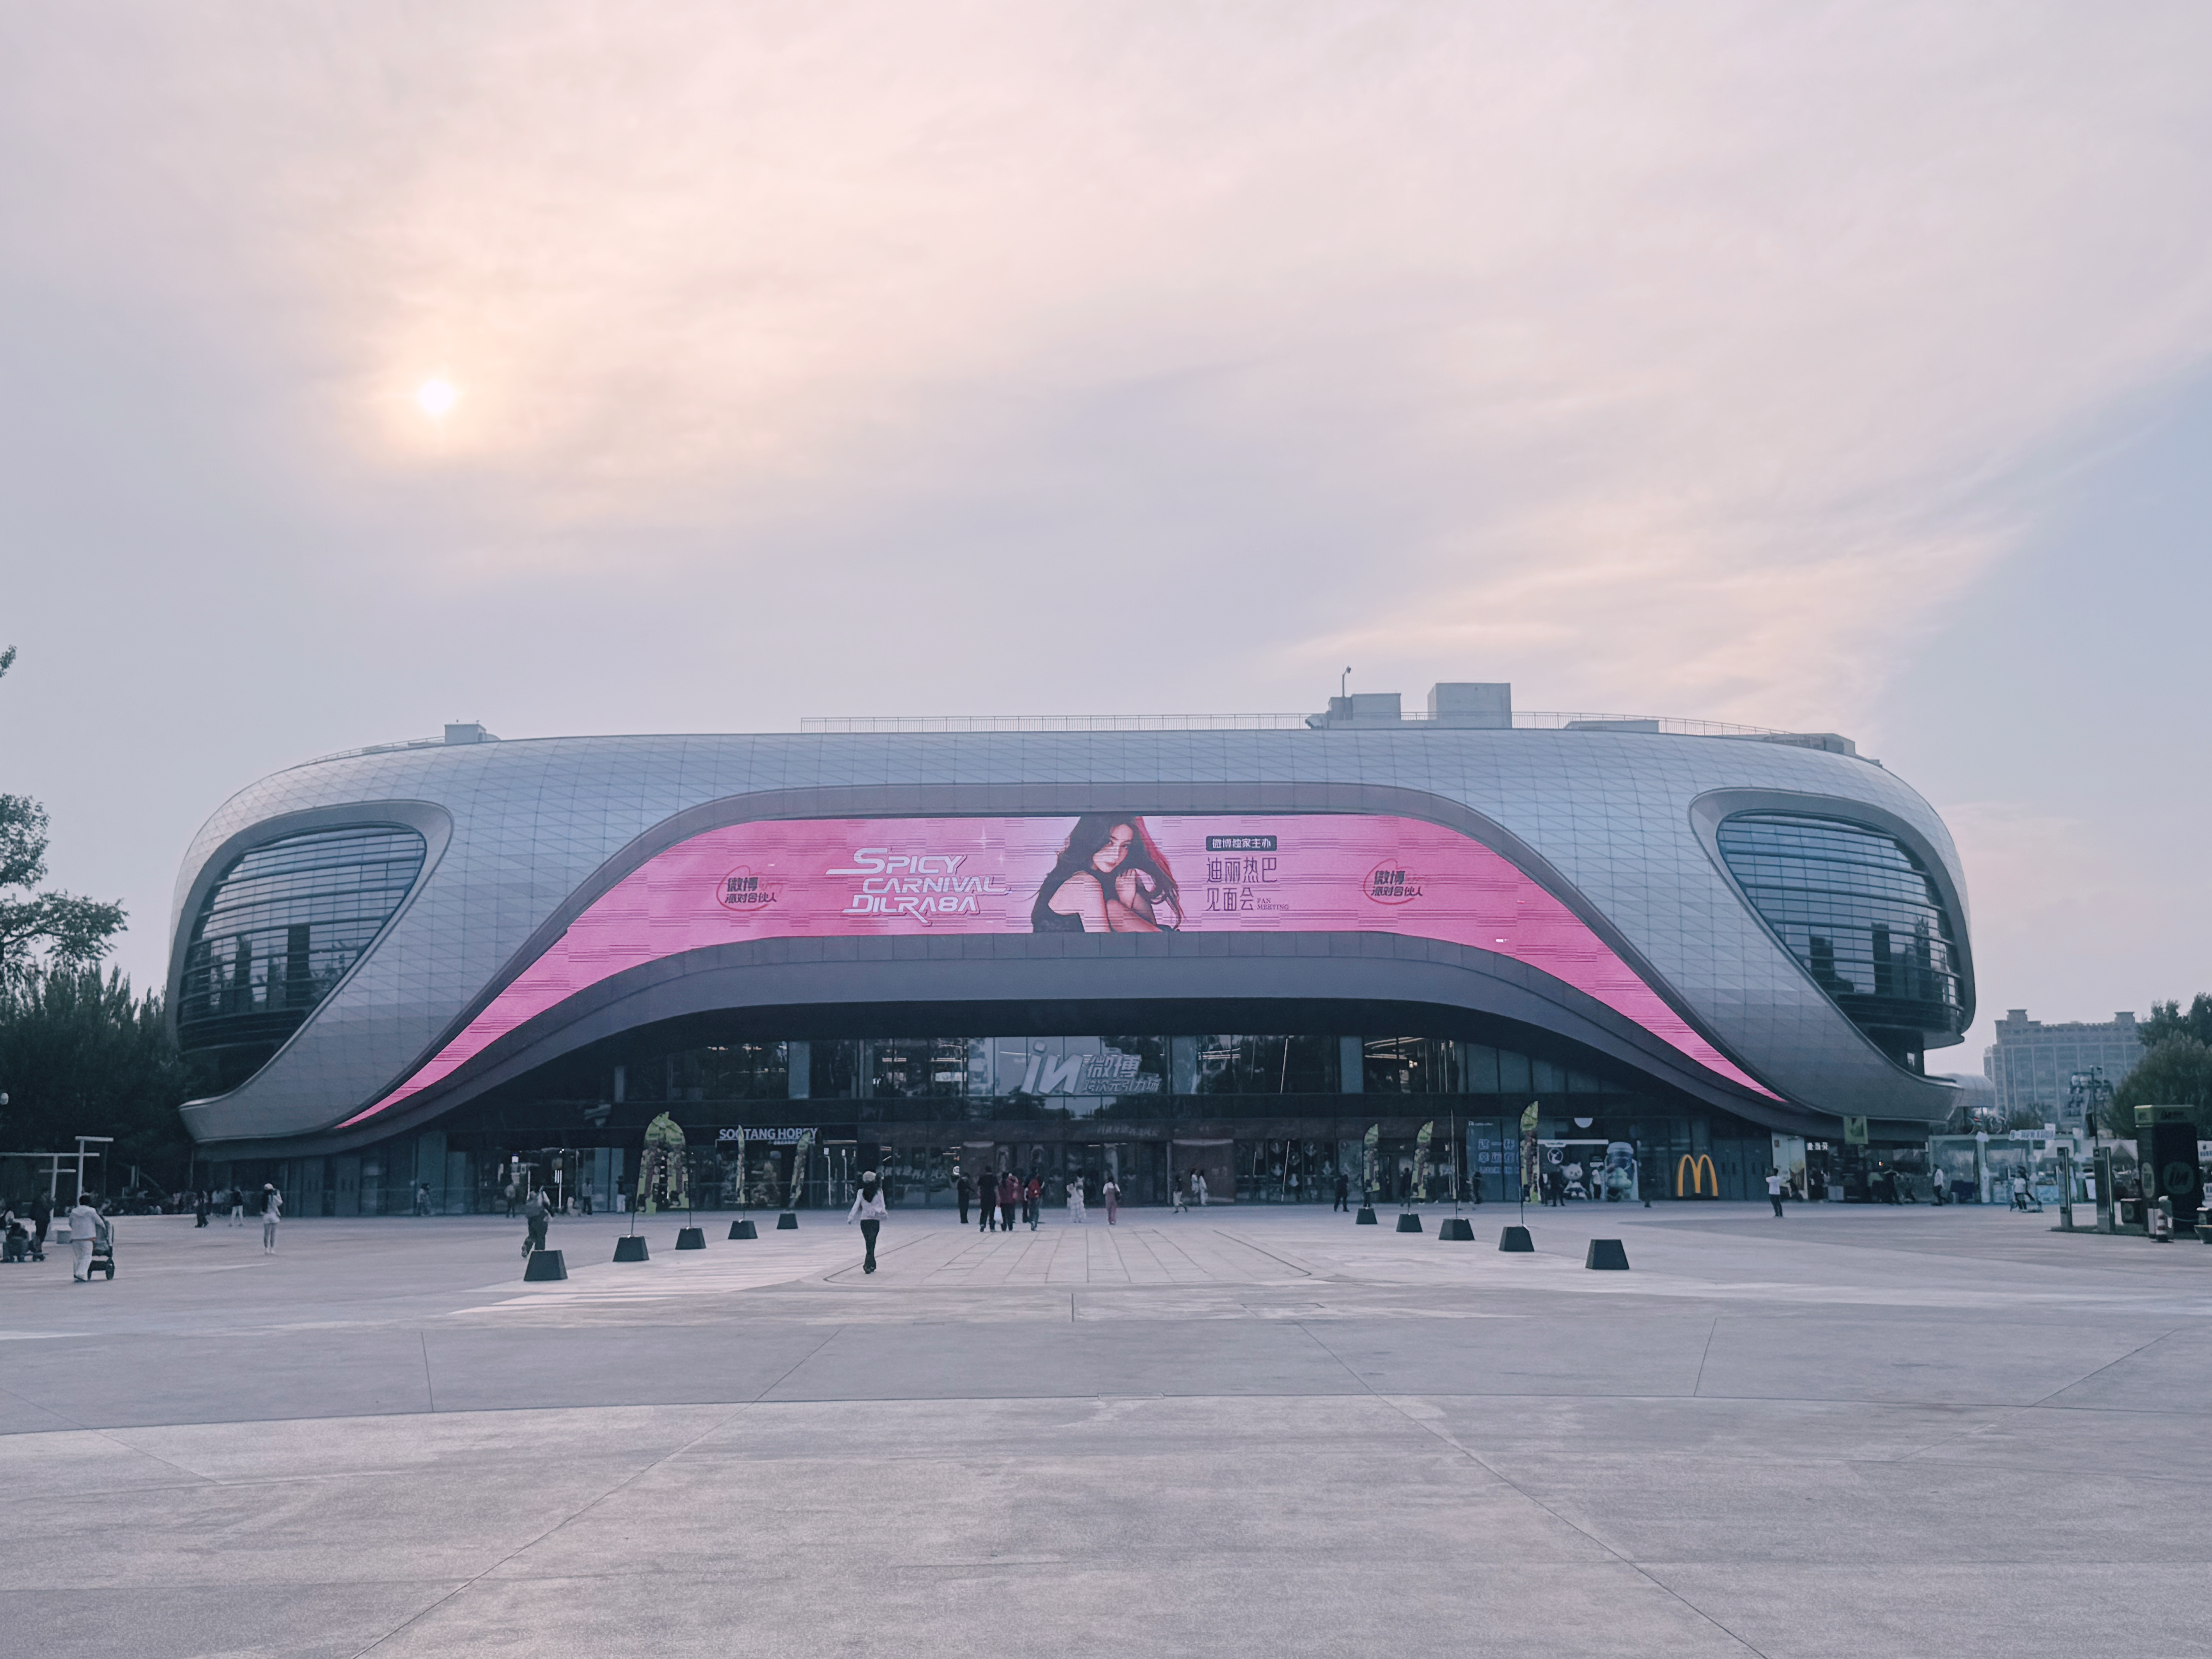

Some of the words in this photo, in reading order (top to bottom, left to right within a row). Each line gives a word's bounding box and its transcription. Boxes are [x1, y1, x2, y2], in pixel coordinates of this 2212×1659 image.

[1212, 838, 1271, 848] 微博独家主办
[825, 848, 964, 875] SPICY
[1206, 856, 1277, 883] 迪丽热巴
[1374, 870, 1405, 884] 微博
[727, 877, 758, 892] 微博
[862, 876, 1007, 894] CARNIVAL
[1371, 886, 1423, 896] 派对合伙人
[725, 892, 777, 903] 派对合伙人
[1205, 887, 1254, 911] 见面会
[1086, 1054, 1142, 1078] 微博
[719, 1128, 776, 1140] SOTANG
